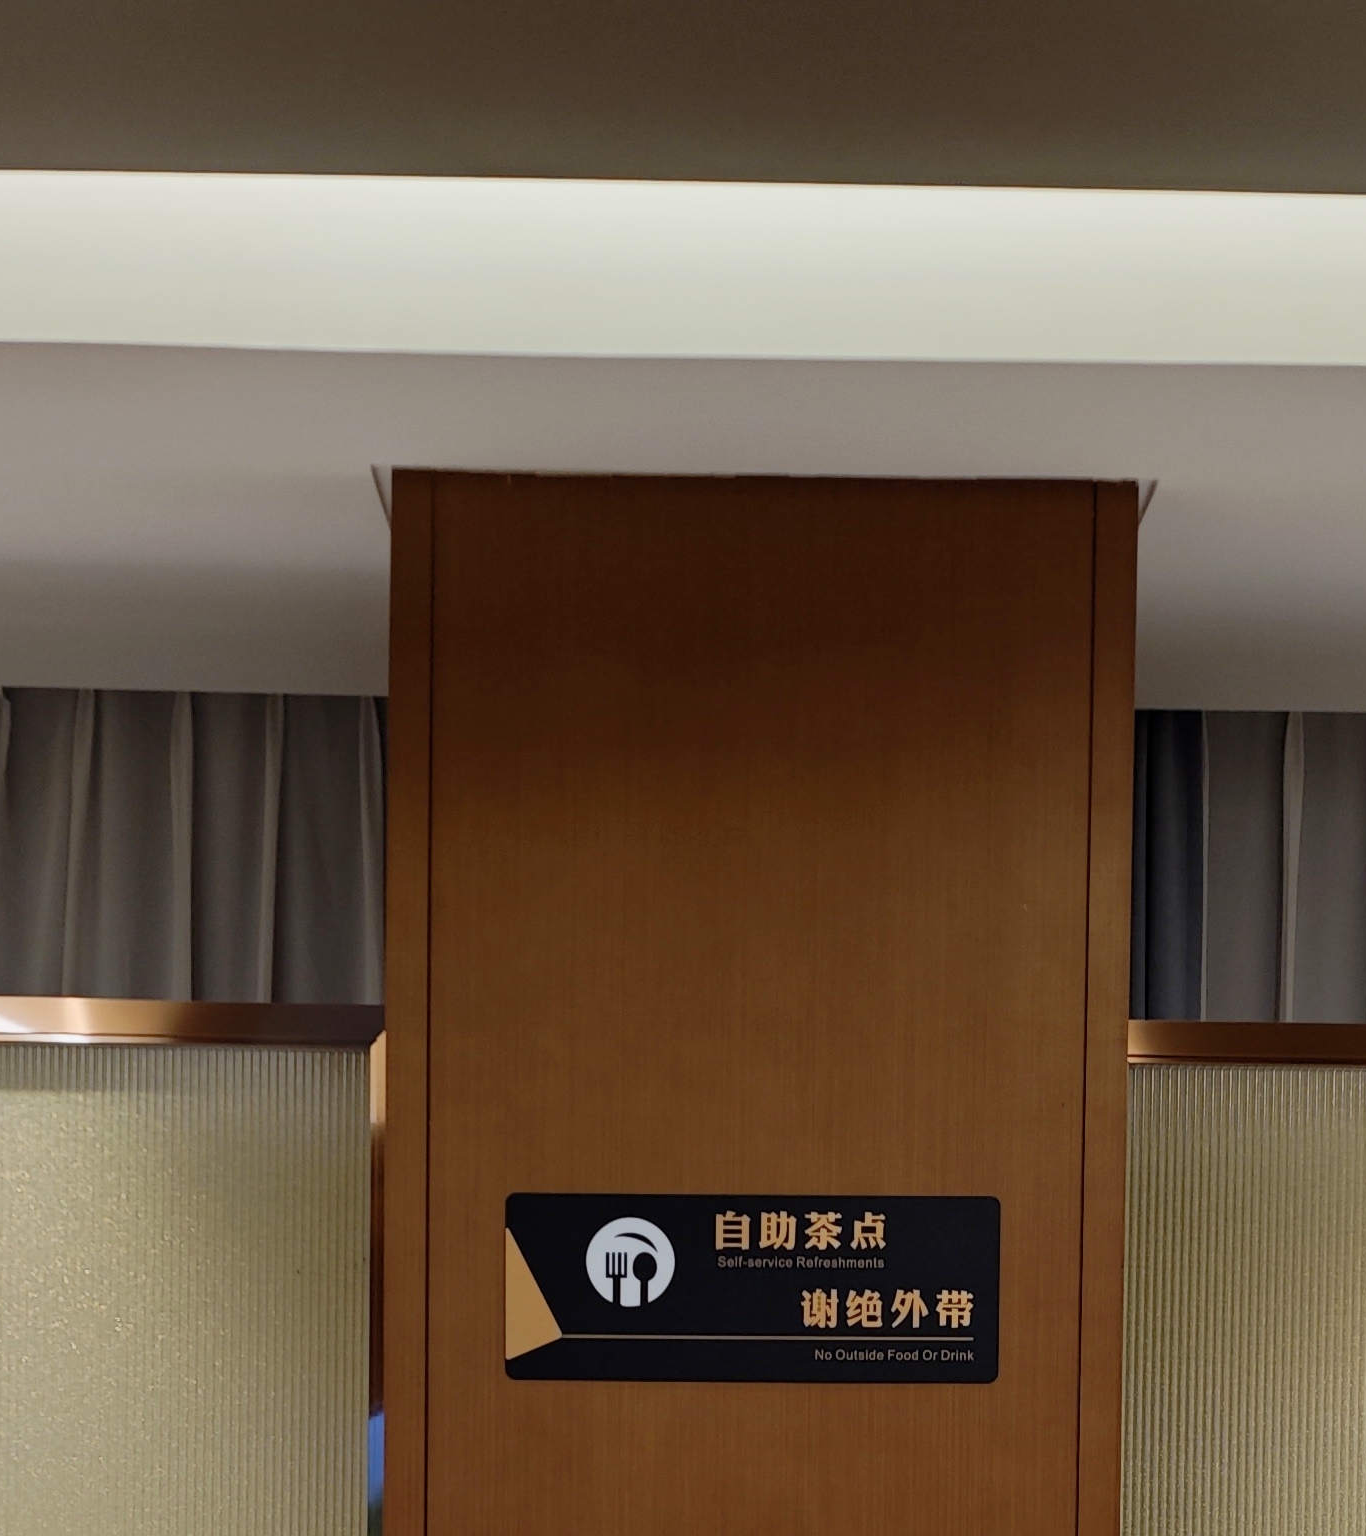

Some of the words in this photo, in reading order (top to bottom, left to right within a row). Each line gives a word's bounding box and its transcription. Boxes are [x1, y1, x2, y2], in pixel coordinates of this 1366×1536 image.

[714, 1210, 887, 1251] 自助茶点
[717, 1255, 793, 1269] Self-service
[796, 1256, 885, 1270] Refreshments
[800, 1287, 975, 1329] 谢绝外带
[814, 1349, 832, 1361] No
[835, 1348, 885, 1362] Outside
[887, 1349, 919, 1362] Food
[922, 1349, 938, 1362] Or
[940, 1349, 975, 1362] Drink
